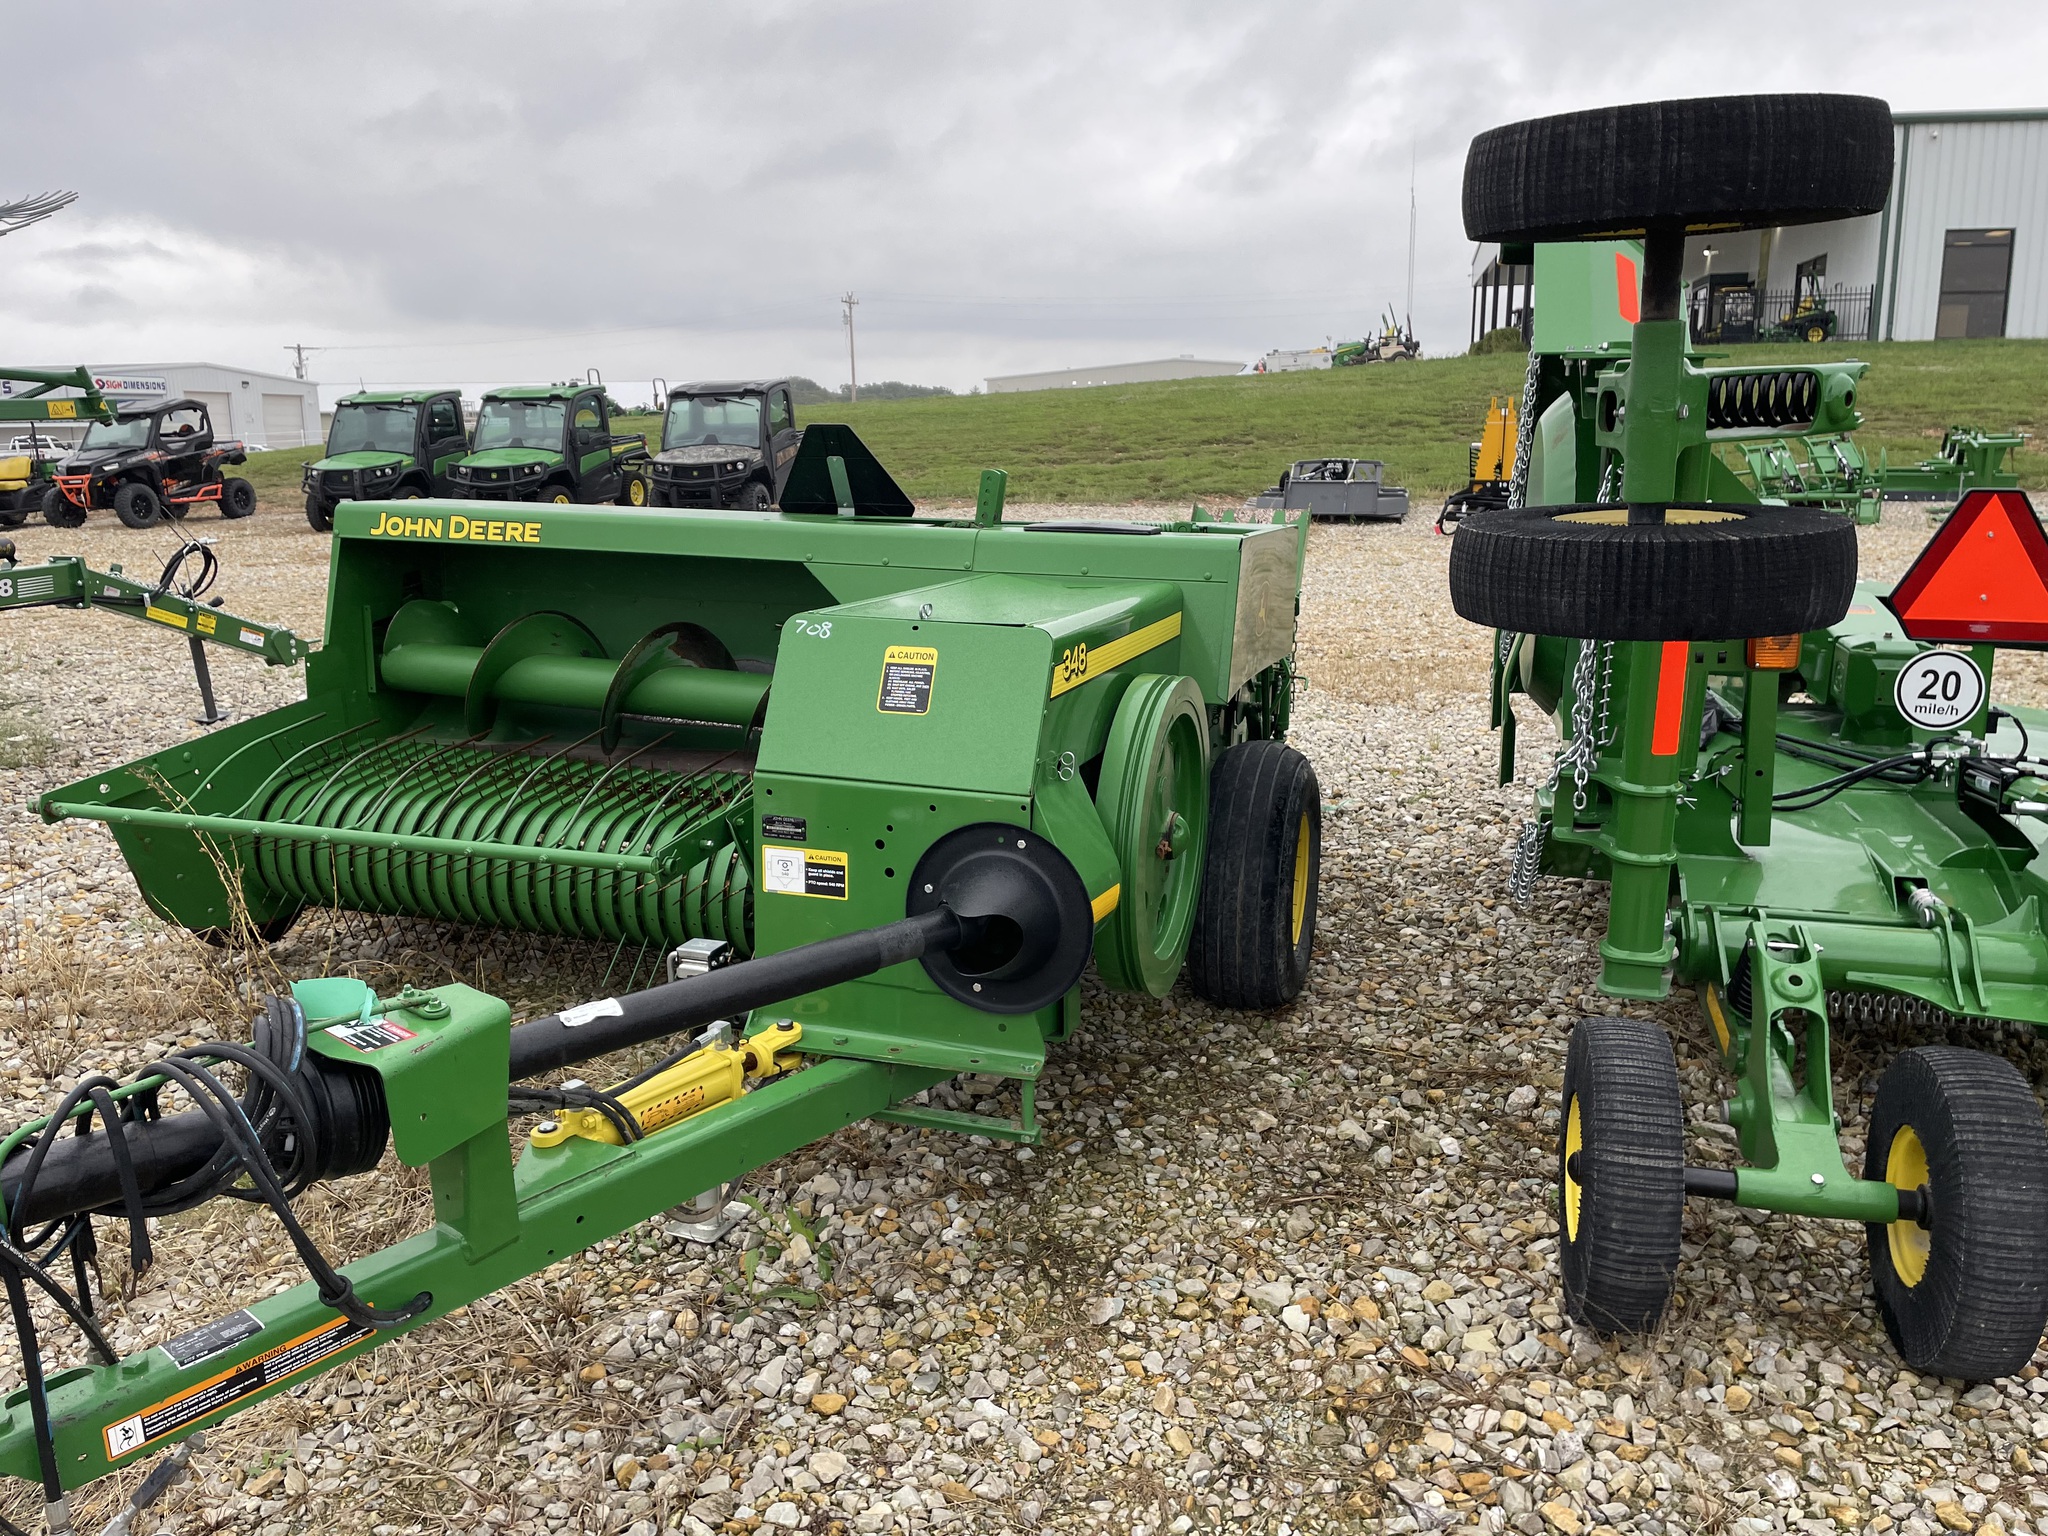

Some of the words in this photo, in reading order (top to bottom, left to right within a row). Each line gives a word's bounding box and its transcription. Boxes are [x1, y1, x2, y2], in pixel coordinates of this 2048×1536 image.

[105, 380, 123, 390] SIGN
[123, 381, 166, 391] DIMENSIONS
[370, 512, 443, 539] JOHN
[448, 515, 542, 543] DEERE
[795, 619, 833, 639] 708
[897, 651, 935, 661] CAUTION
[1063, 642, 1087, 681] 348
[1917, 669, 1962, 701] 20
[1914, 703, 1959, 716] mile/h
[814, 854, 842, 862] CAUTION
[243, 1345, 287, 1372] WARNING
